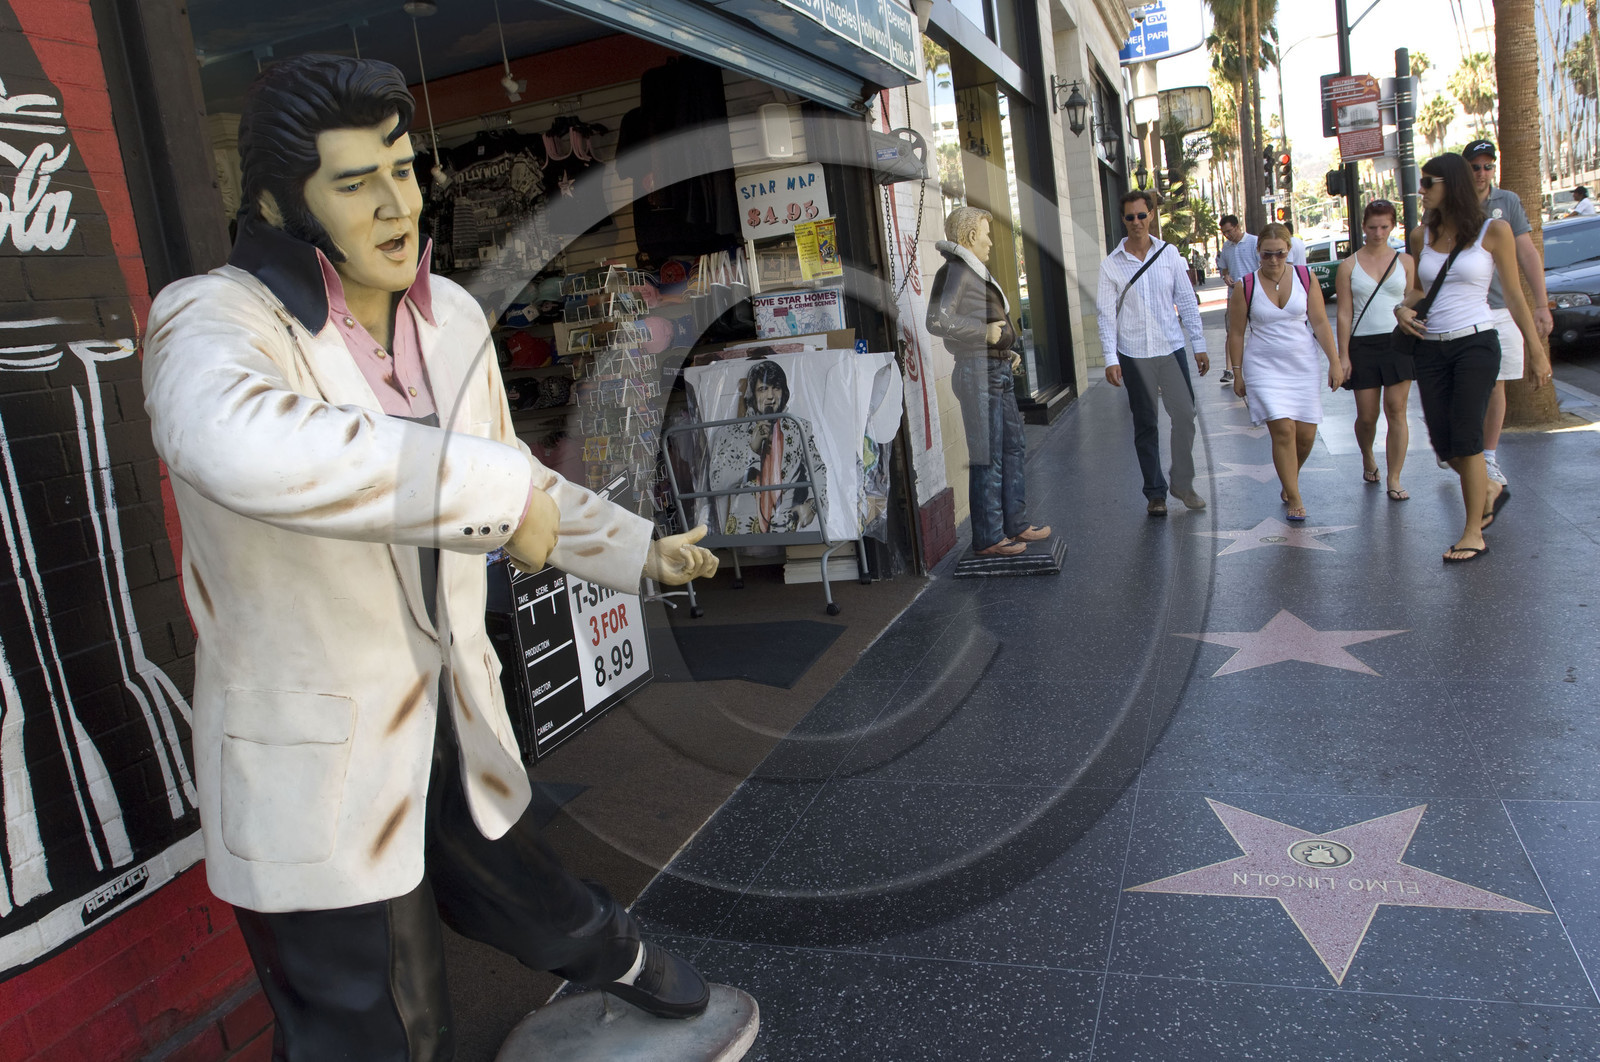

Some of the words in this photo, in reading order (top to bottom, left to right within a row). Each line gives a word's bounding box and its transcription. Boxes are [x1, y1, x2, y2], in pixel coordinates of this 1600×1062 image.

[825, 1, 857, 31] Angeles
[887, 4, 911, 40] Beverly
[860, 14, 888, 48] Hollywood
[891, 39, 909, 65] Hills
[454, 159, 510, 184] OLLYWOOD
[741, 180, 776, 199] STAR
[787, 173, 815, 190] MAP
[747, 200, 819, 229] $4.95
[753, 298, 775, 308] OVIE
[777, 295, 802, 305] STAR
[804, 291, 837, 302] HOMES
[517, 593, 529, 605] TAKE
[535, 584, 549, 597] SCENE
[553, 577, 564, 588] DATE
[589, 616, 600, 647] 3
[601, 603, 629, 639] FOR
[525, 639, 551, 659] PRODUCTION
[594, 639, 634, 688] 8.99
[531, 681, 552, 699] DIRECTOR
[536, 720, 554, 736] CAMERA
[1233, 872, 1335, 890] LINCOLN
[1348, 878, 1421, 894] ELMO
